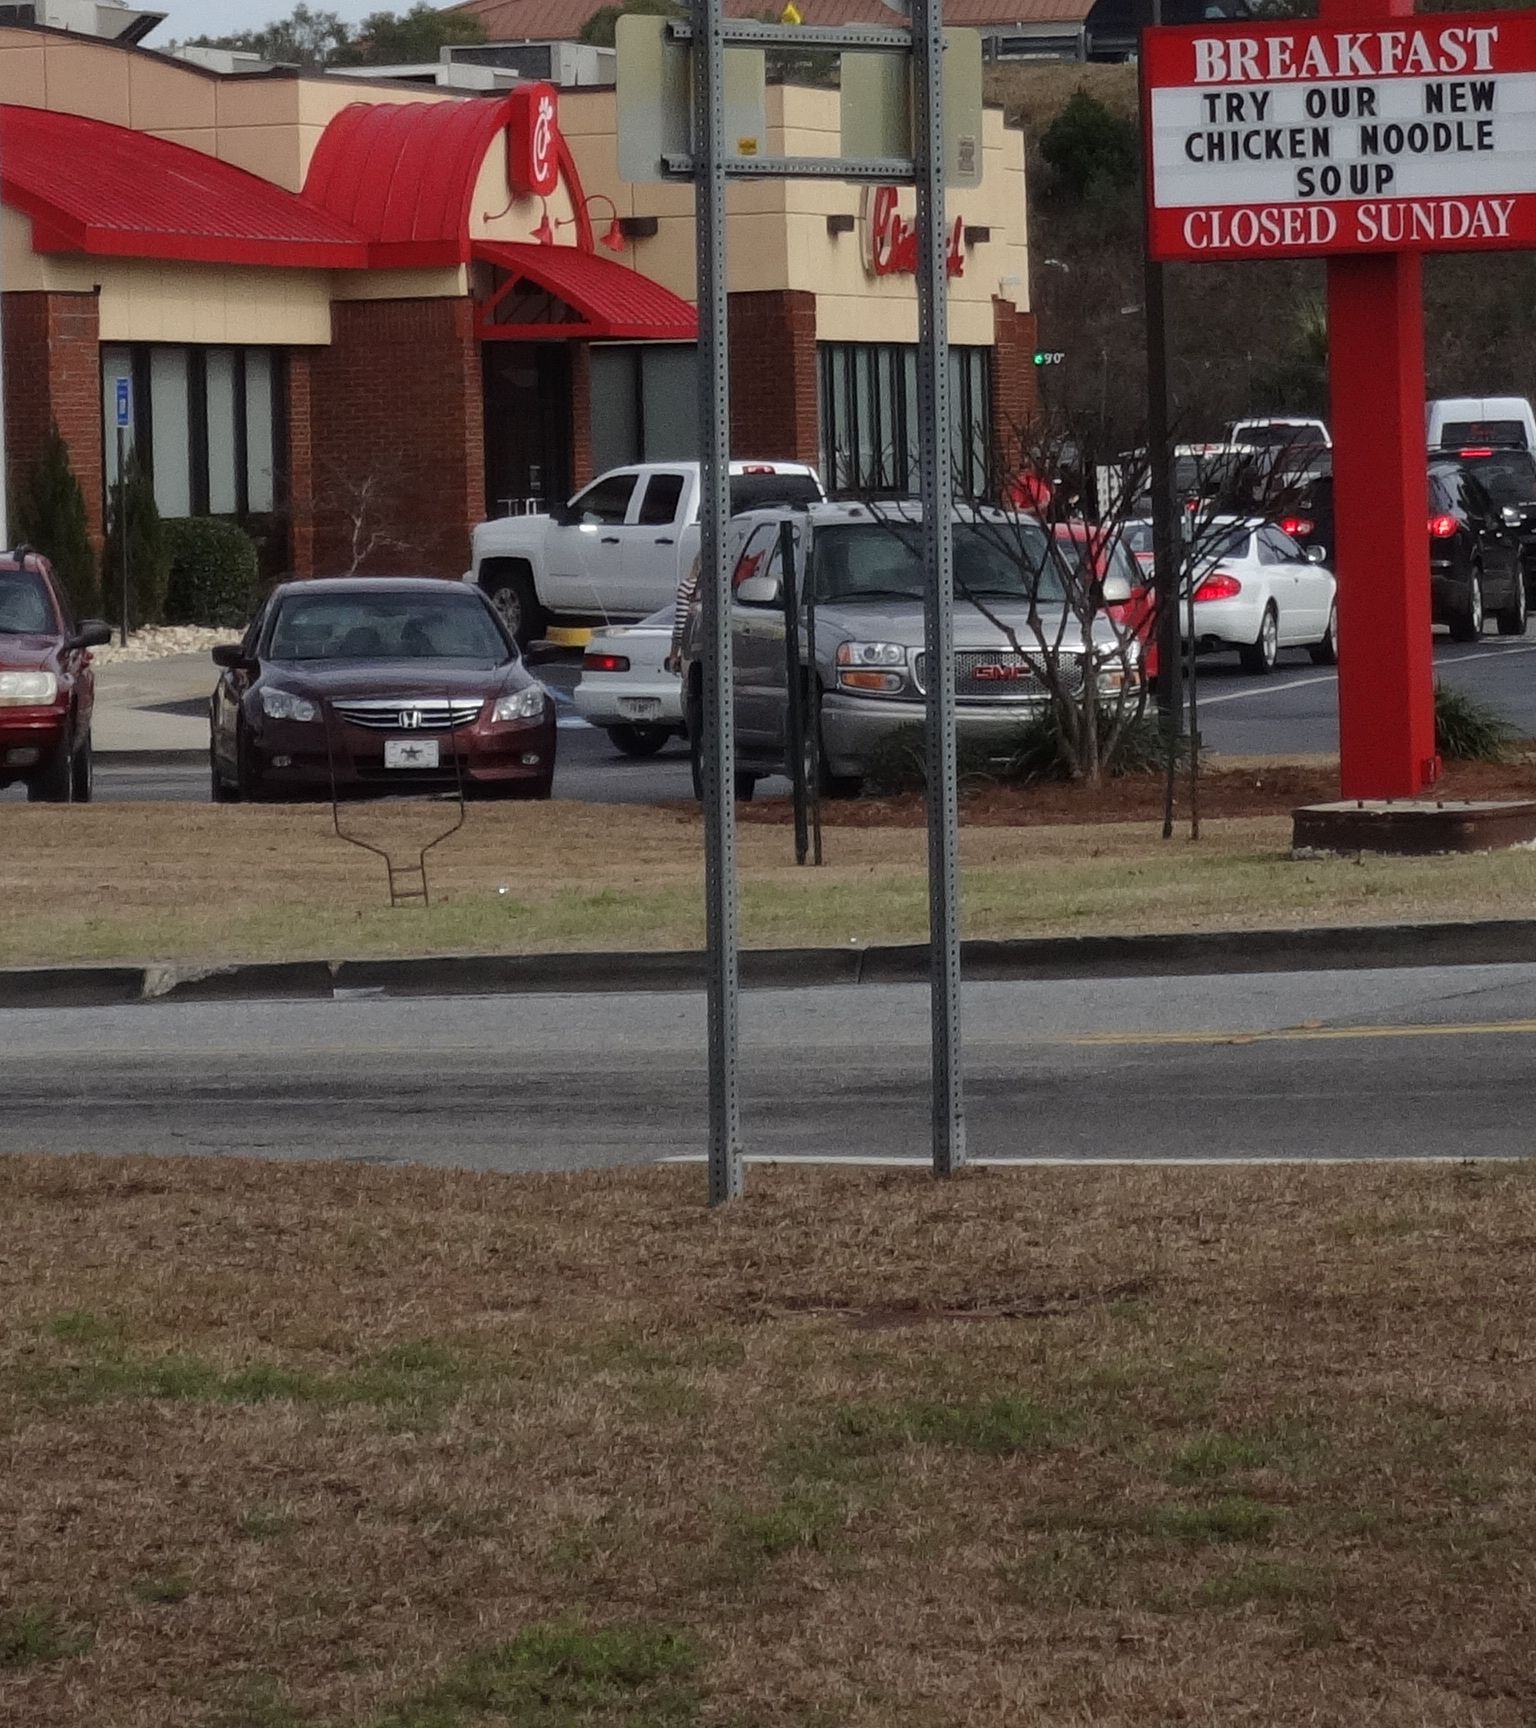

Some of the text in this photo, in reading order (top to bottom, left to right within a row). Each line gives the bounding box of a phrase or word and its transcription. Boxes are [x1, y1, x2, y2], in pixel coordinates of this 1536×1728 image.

[1191, 25, 1499, 83] BREAKFAST
[1202, 80, 1496, 123] TRY OUR NEW
[1184, 120, 1495, 162] CHICKEN NOODLE
[1295, 163, 1395, 198] SOUP
[1182, 198, 1517, 250] CLOSED SUNDAY
[972, 665, 1035, 681] GMC
